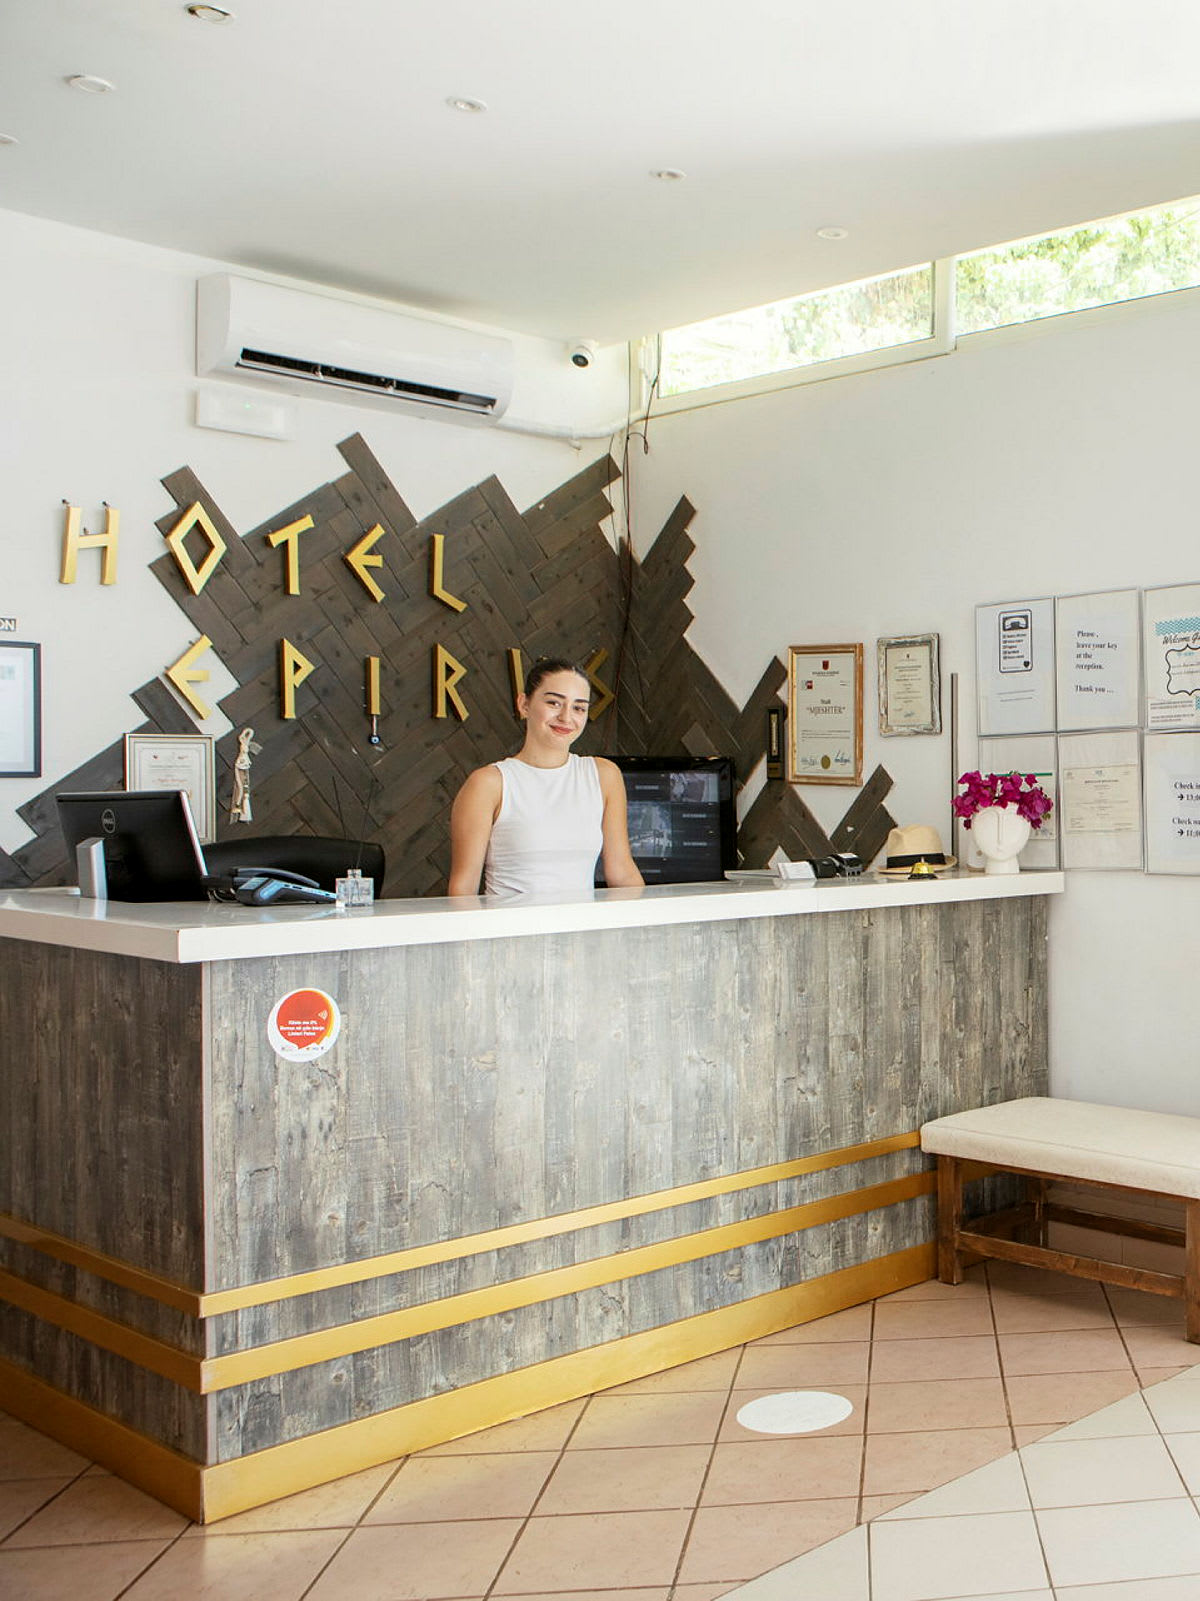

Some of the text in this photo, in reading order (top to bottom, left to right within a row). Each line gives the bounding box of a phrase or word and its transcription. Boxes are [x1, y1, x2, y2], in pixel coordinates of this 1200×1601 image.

[59, 501, 468, 613] HOTEL
[1107, 641, 1118, 651] key
[1173, 782, 1194, 790] Check
[1172, 817, 1193, 825] Check
